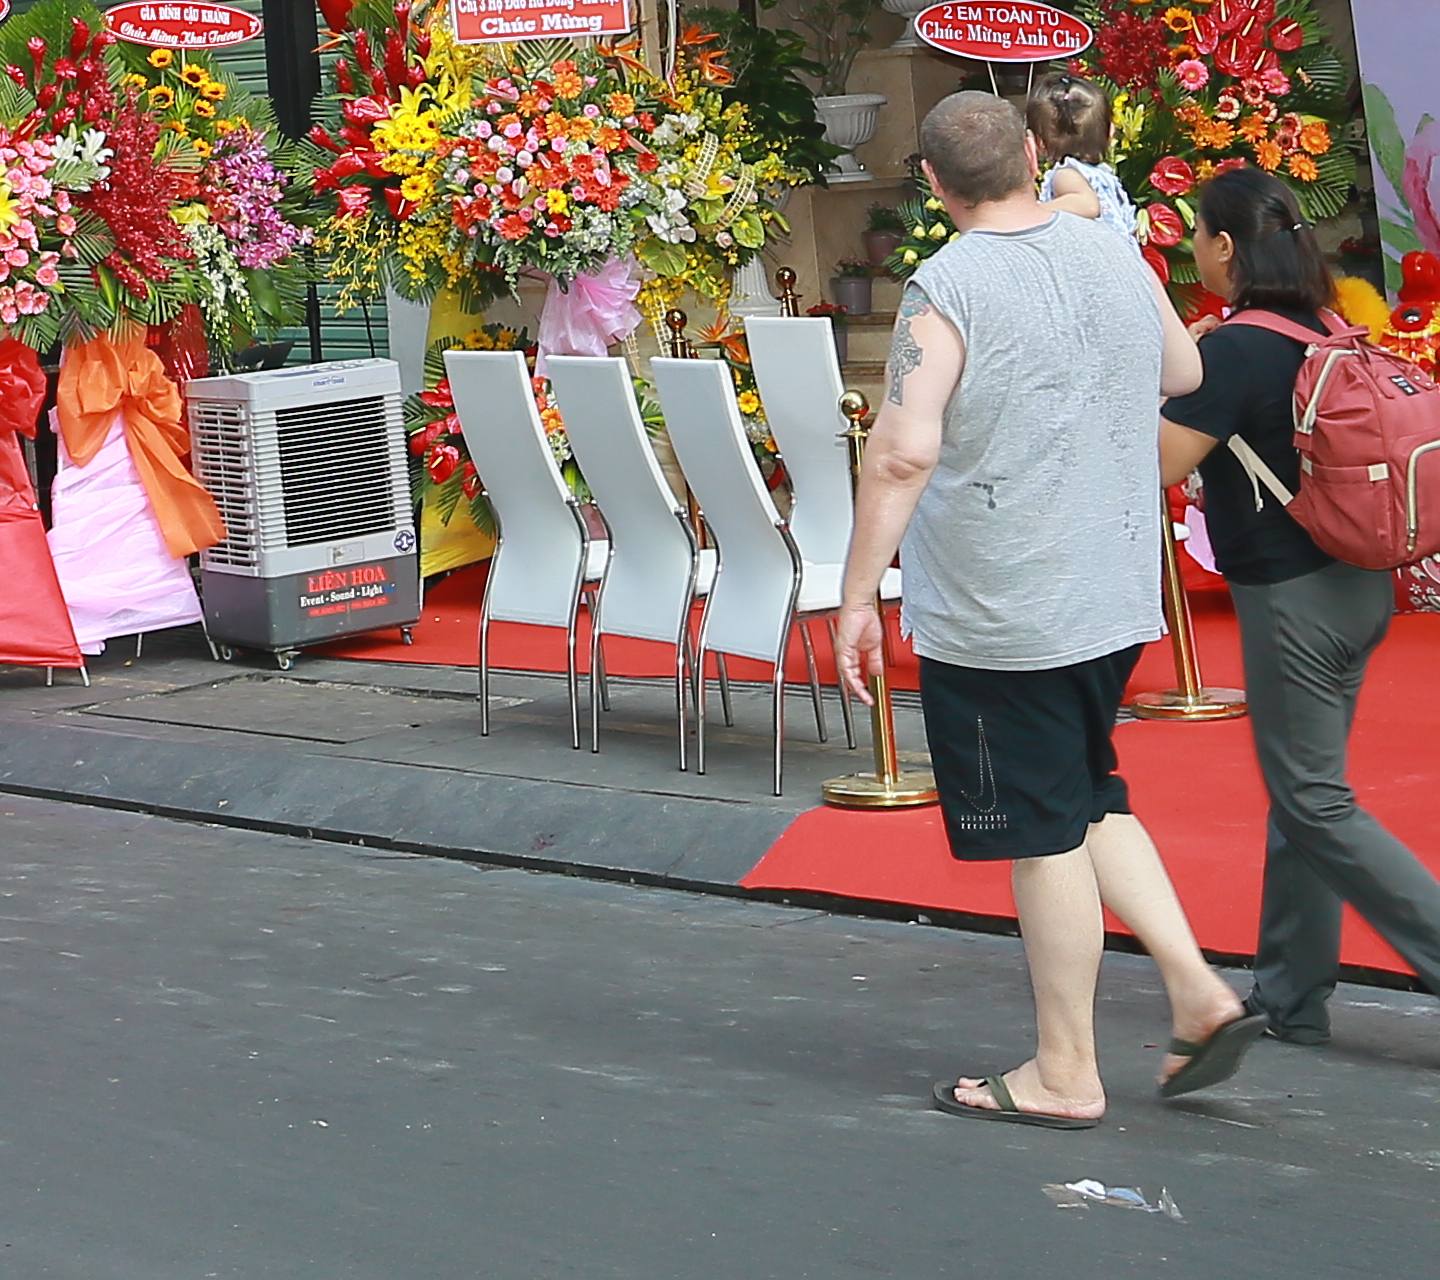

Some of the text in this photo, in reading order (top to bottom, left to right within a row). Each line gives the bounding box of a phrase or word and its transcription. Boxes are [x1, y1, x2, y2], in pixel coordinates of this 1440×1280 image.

[480, 11, 604, 36] Chúc Mừng
[942, 5, 954, 20] 2
[957, 6, 983, 21] EM
[986, 5, 1034, 25] TOÀN
[921, 20, 964, 41] Chúc
[967, 23, 1012, 49] Mừng
[1015, 27, 1049, 47] Anh
[307, 565, 387, 594] LIÊN HOA
[299, 583, 383, 608] Event Sound Light
